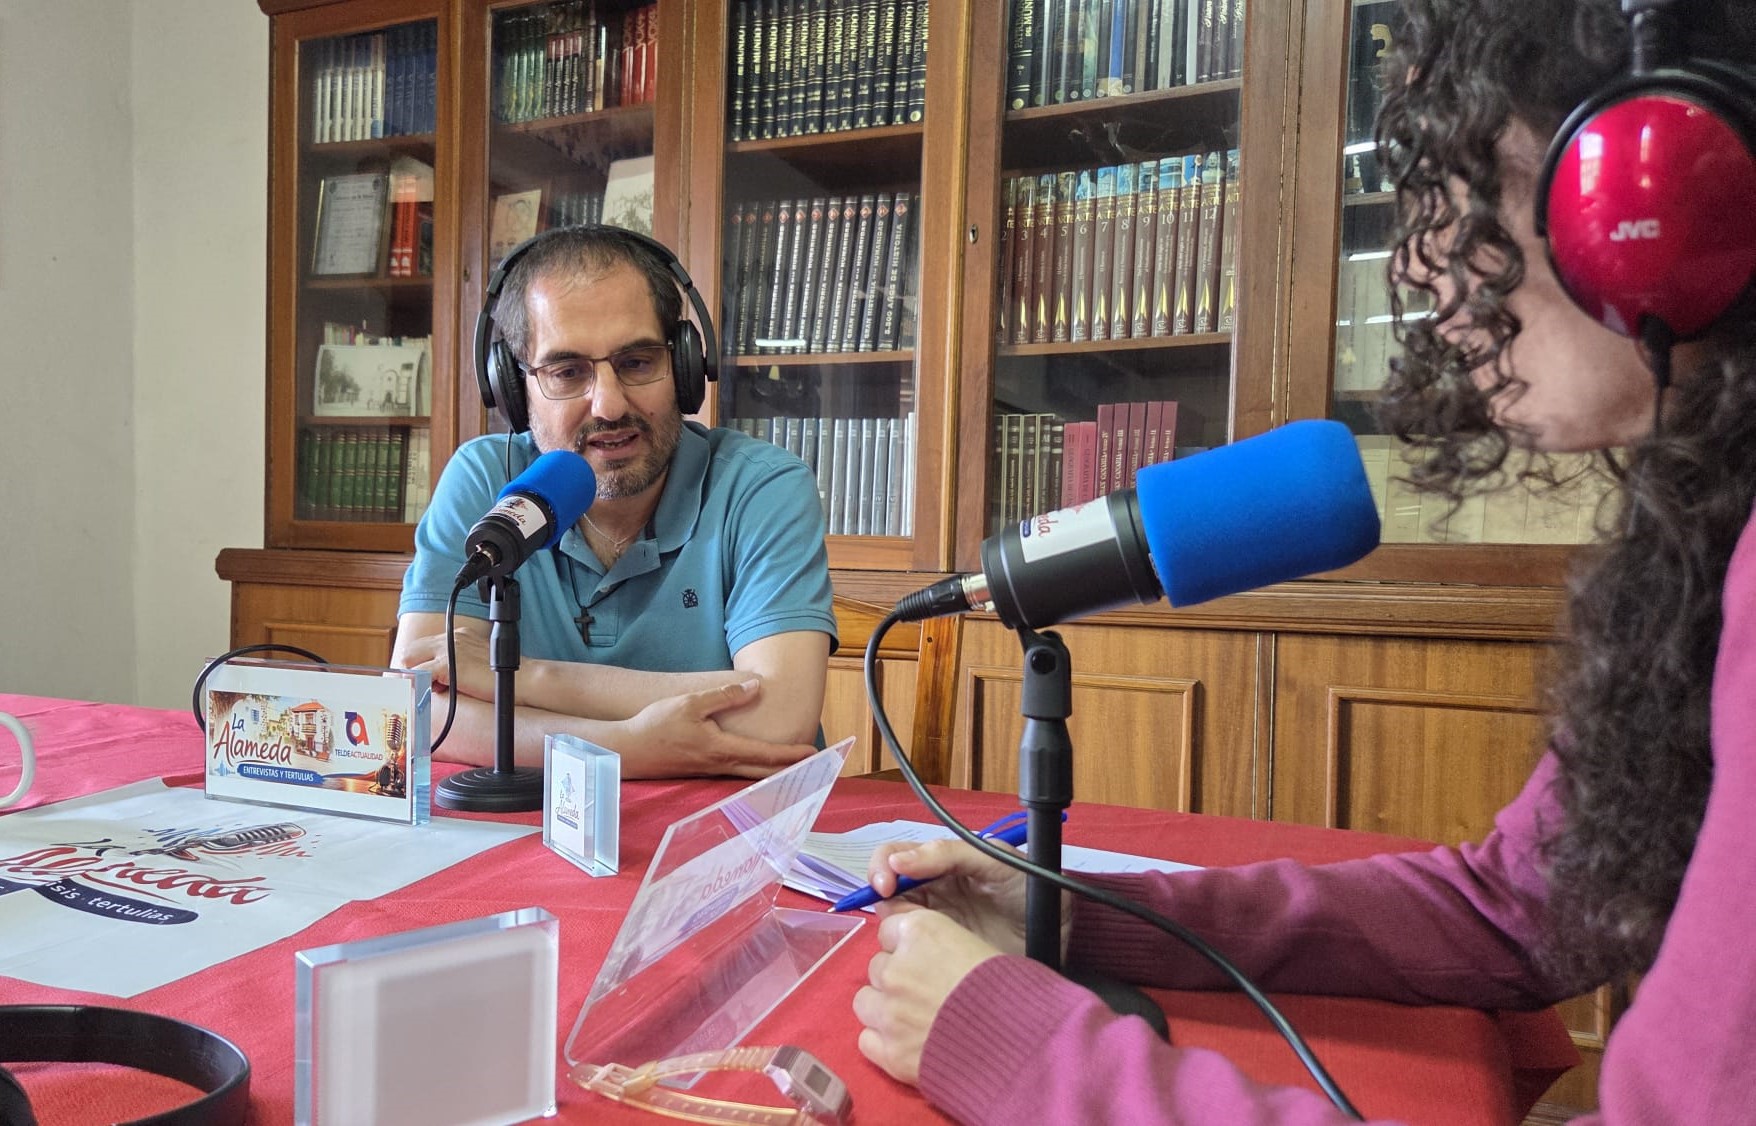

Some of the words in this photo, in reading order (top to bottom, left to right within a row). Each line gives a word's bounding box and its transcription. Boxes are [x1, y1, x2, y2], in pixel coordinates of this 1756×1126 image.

[1143, 216, 1151, 228] 9
[1162, 213, 1174, 225] 10
[1184, 210, 1194, 222] 11
[1080, 224, 1088, 234] 6
[1102, 222, 1108, 232] 7
[1121, 218, 1130, 230] 8
[1610, 218, 1660, 241] JVC
[1060, 226, 1068, 236] 5
[892, 222, 904, 268] HISTORIA
[232, 713, 244, 732] La
[214, 720, 292, 767] Alameda
[335, 748, 384, 760] TELDEACTUALIDAD
[244, 766, 278, 778] ENTREVISTAS
[280, 770, 284, 778] Y
[285, 771, 314, 782] TERTULIAS
[88, 896, 174, 921] tertulias
